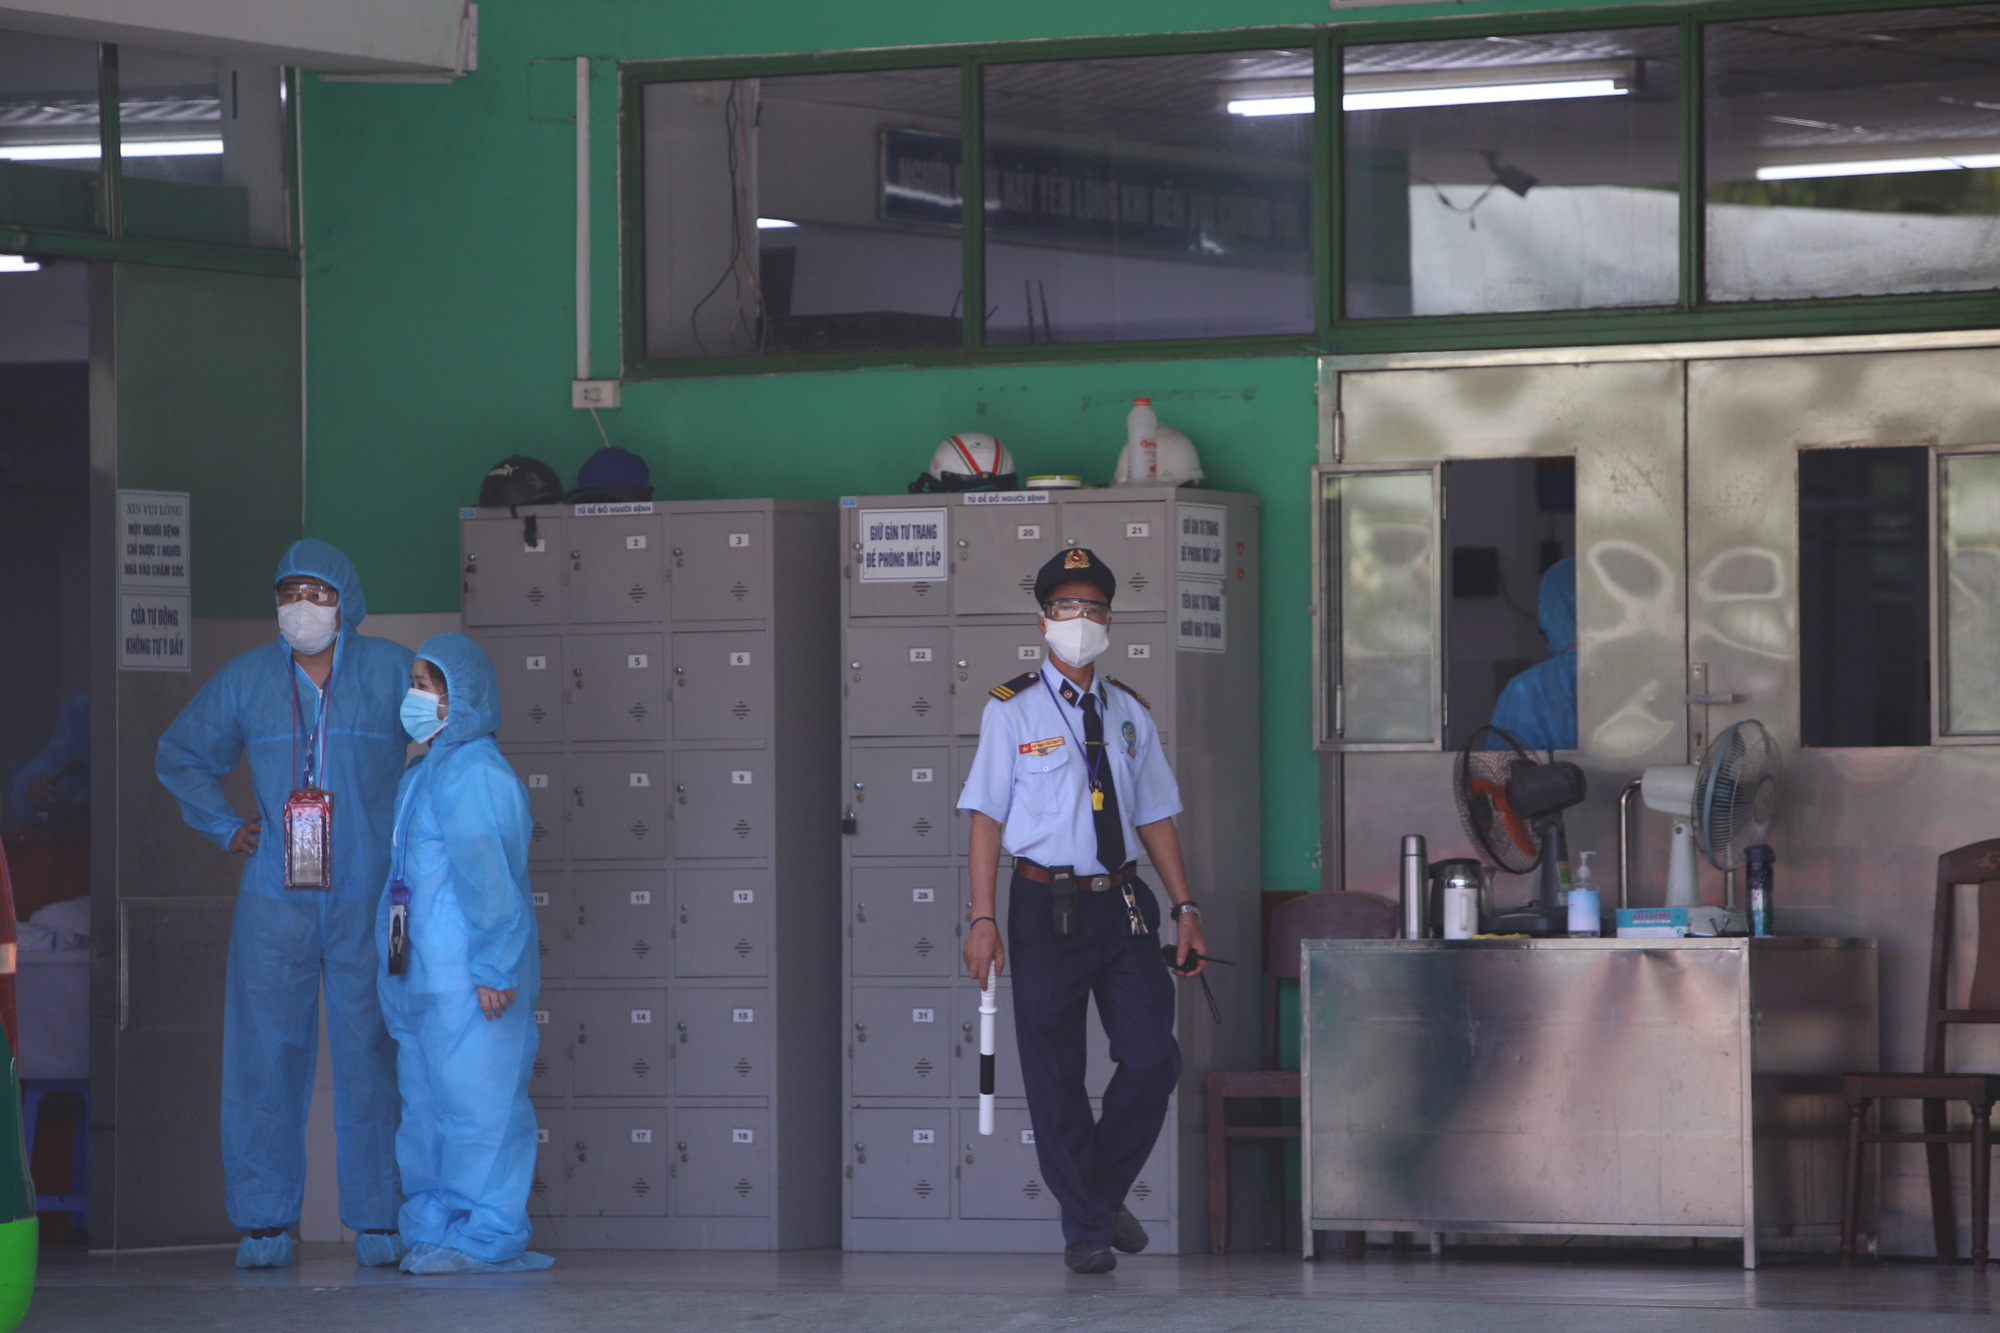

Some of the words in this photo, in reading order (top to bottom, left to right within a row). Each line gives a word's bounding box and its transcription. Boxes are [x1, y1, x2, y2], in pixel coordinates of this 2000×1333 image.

[126, 503, 140, 514] XIN
[142, 503, 157, 515] VUI
[159, 501, 182, 516] LÒNG
[900, 522, 911, 540] TƯ
[912, 524, 937, 540] TRANG
[1023, 529, 1034, 537] 20
[1132, 526, 1142, 534] 21
[878, 547, 905, 567] PHÒNG
[907, 545, 923, 567] MẤT
[925, 545, 941, 567] CẮP
[158, 605, 178, 630] ĐỘNG
[125, 633, 150, 654] KHÔNG
[915, 651, 926, 659] 22
[1024, 649, 1035, 657] 23
[1133, 648, 1144, 656] 24
[917, 772, 927, 780] 25
[534, 896, 543, 904] 10
[635, 894, 645, 902] 11
[738, 893, 748, 901] 12
[918, 892, 928, 900] 28
[535, 1013, 544, 1021] 13
[636, 1013, 646, 1021] 14
[537, 1132, 543, 1140] 6
[636, 1132, 646, 1140] 17
[918, 1133, 928, 1141] 34
